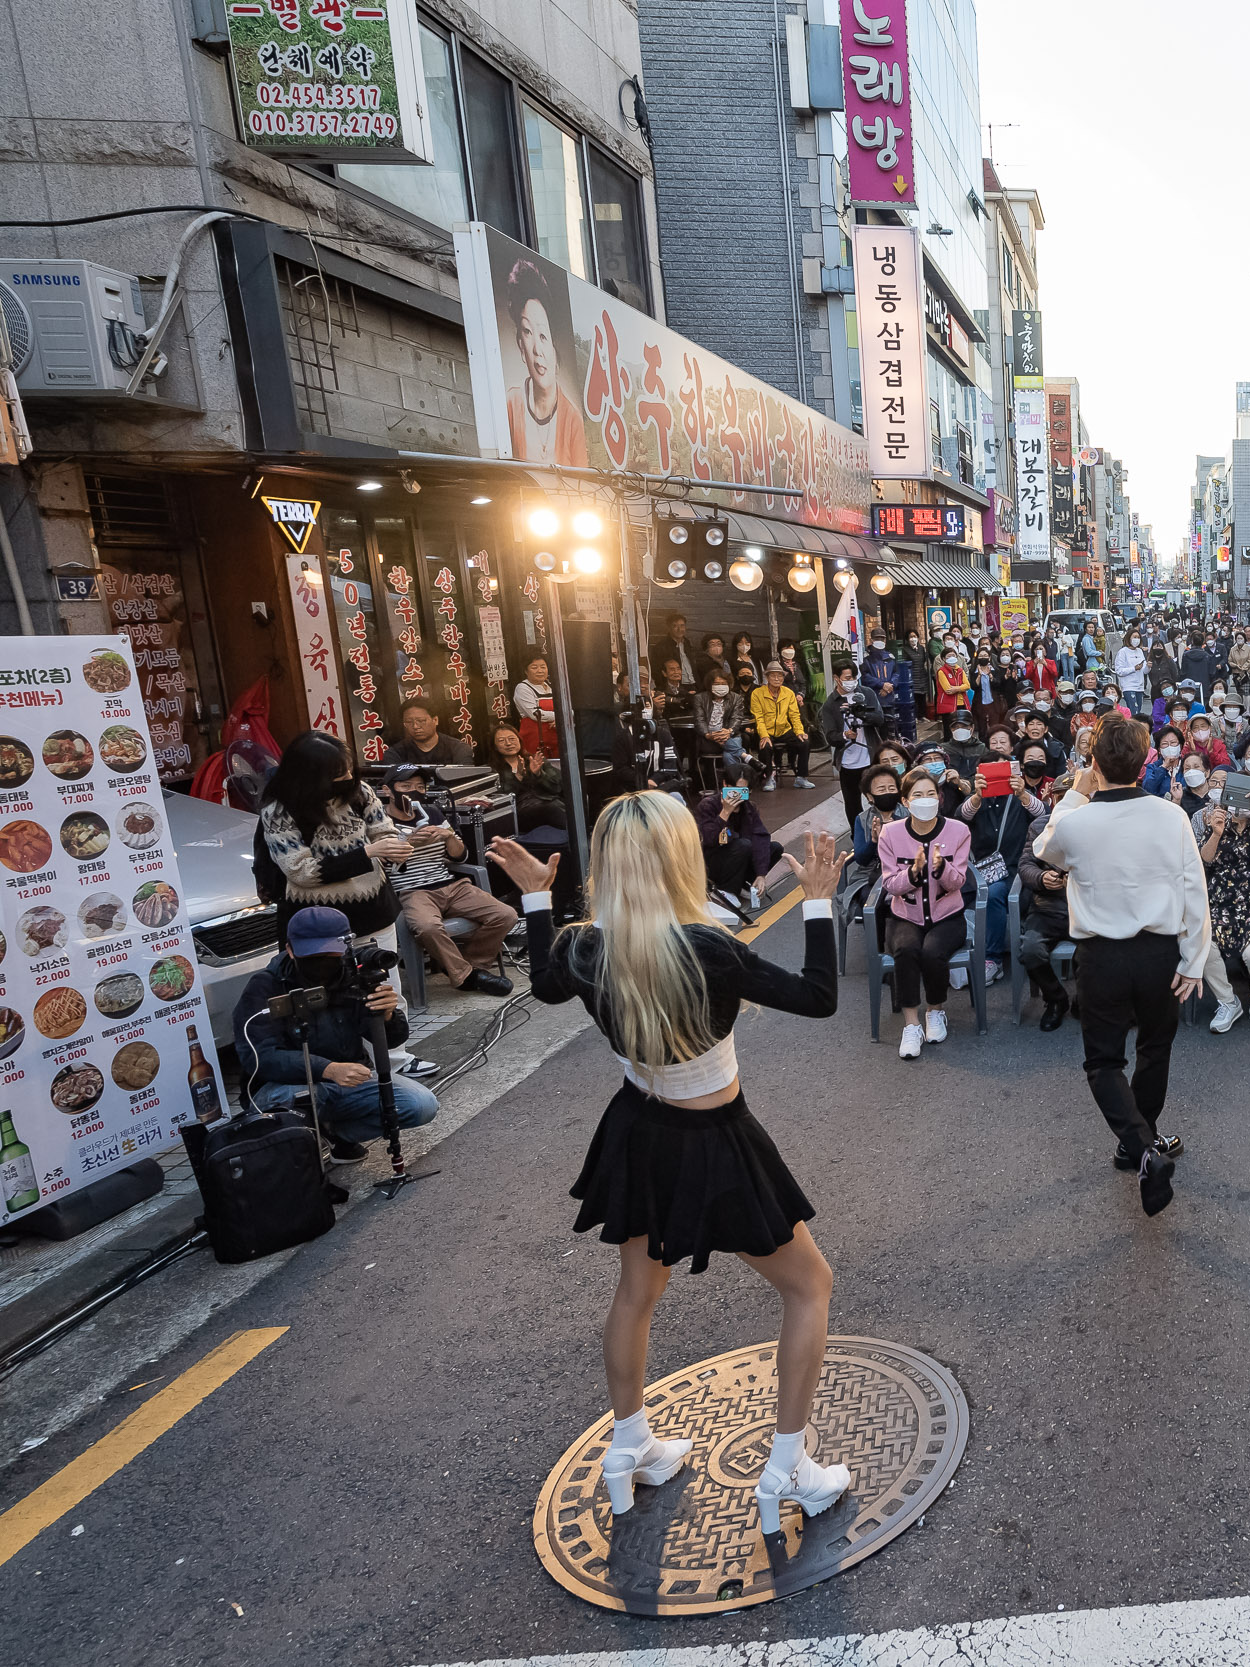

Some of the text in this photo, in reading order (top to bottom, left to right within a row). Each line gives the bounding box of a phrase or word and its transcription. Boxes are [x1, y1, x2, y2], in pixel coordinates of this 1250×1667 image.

[849, 0, 905, 171] 노래방
[259, 85, 380, 107] 02.454.3517
[251, 112, 396, 136] 010.3757.2749
[12, 273, 81, 286] SAMSUNG
[1019, 438, 1046, 532] 대봉갈비
[267, 500, 317, 525] TERRA
[68, 580, 88, 596] 38
[113, 599, 158, 620] 안창살
[813, 640, 852, 652] TRRA
[156, 672, 186, 692] 목살
[100, 708, 131, 719] 19.000
[57, 782, 95, 796] 부대찌개
[116, 785, 148, 797] 12.000
[61, 793, 95, 805] 17.000
[0, 801, 34, 815] 17.000
[128, 849, 164, 863] 두부김치
[77, 860, 106, 875] 황태탕
[133, 861, 164, 875] 15.000
[78, 872, 111, 887] 17.000
[17, 884, 52, 900] 12.000
[150, 937, 180, 952] 16.000
[29, 956, 71, 975] 낙지소면
[96, 952, 128, 968] 19.000
[35, 968, 71, 986] 22.000
[166, 1010, 196, 1026] 18.000
[113, 1027, 146, 1045] 15.000
[53, 1047, 88, 1066] 16.000
[129, 1097, 161, 1116] 13.000
[71, 1121, 105, 1140] 12.000
[120, 1124, 143, 1139] 제대로
[81, 1144, 121, 1173] 초신선
[138, 1126, 163, 1146] 라거
[43, 1166, 64, 1183] 소주
[41, 1177, 71, 1197] 5.000
